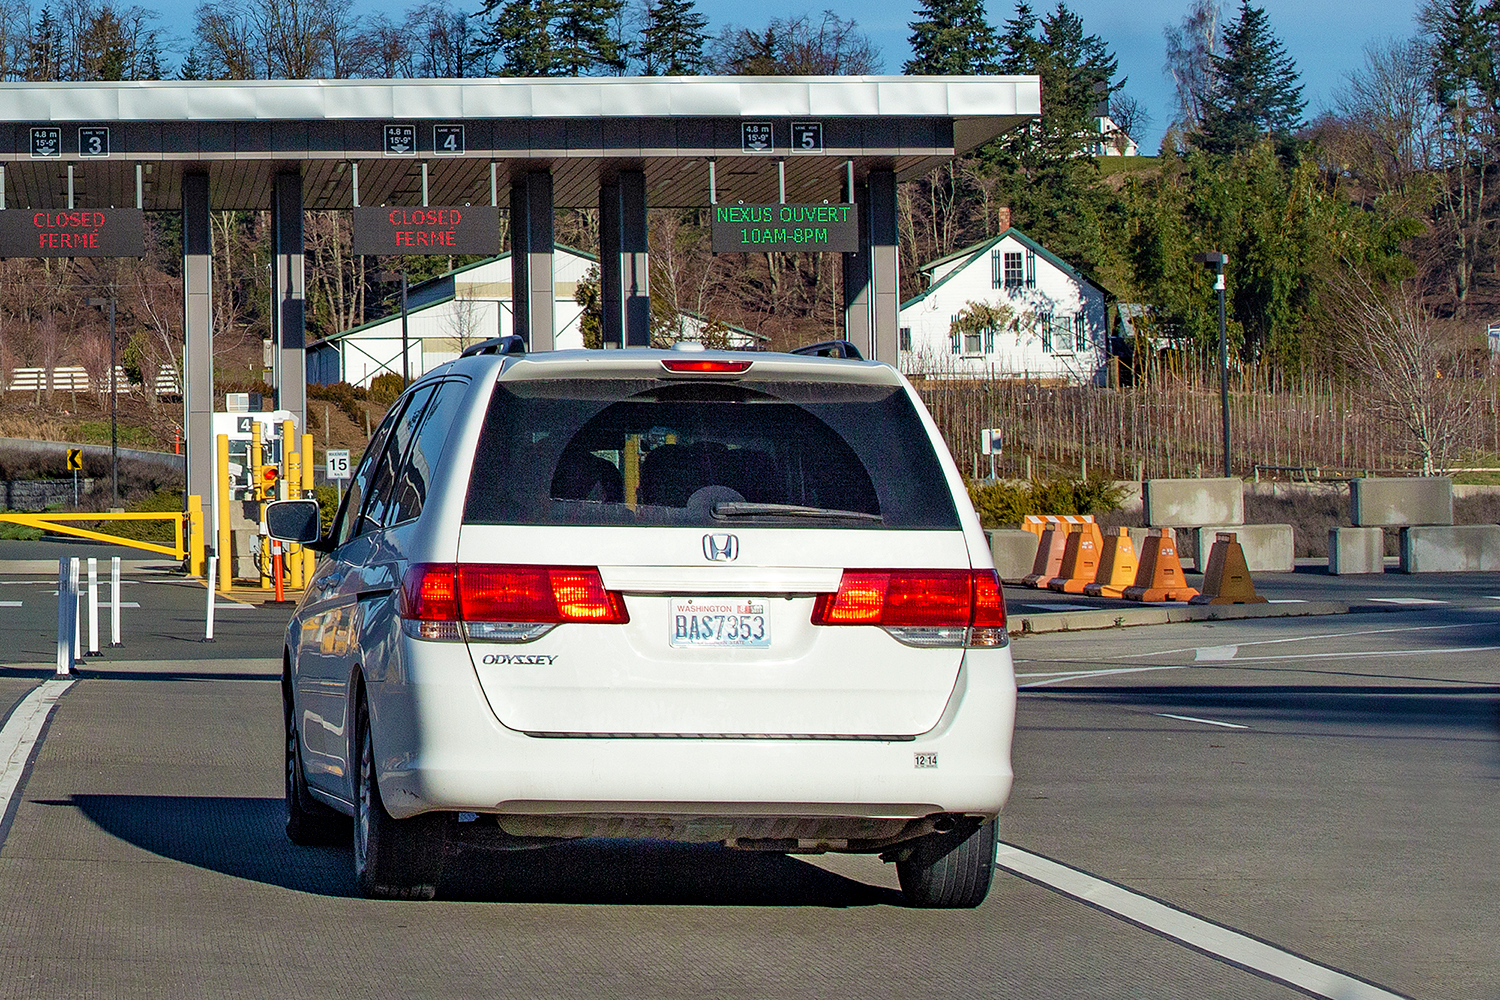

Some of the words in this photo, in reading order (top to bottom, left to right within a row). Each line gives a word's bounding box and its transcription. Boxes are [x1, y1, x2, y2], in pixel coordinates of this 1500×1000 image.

[88, 136, 102, 154] 3
[443, 134, 457, 151] 4
[802, 132, 815, 149] 5
[33, 212, 106, 228] CLOSED
[388, 209, 462, 225] CLOSED
[716, 207, 773, 223] NEXUS
[779, 207, 851, 222] OUVERT
[39, 228, 101, 249] FERMÉ
[395, 226, 457, 247] FERMÉ
[740, 228, 828, 244] 10AM-8PM
[240, 418, 251, 432] 4
[329, 458, 348, 471] 15
[676, 605, 732, 613] WASHINGTON
[675, 614, 765, 640] BAS7353
[482, 654, 559, 665] ODYSSEY
[915, 755, 925, 765] 12
[927, 755, 938, 765] 14
